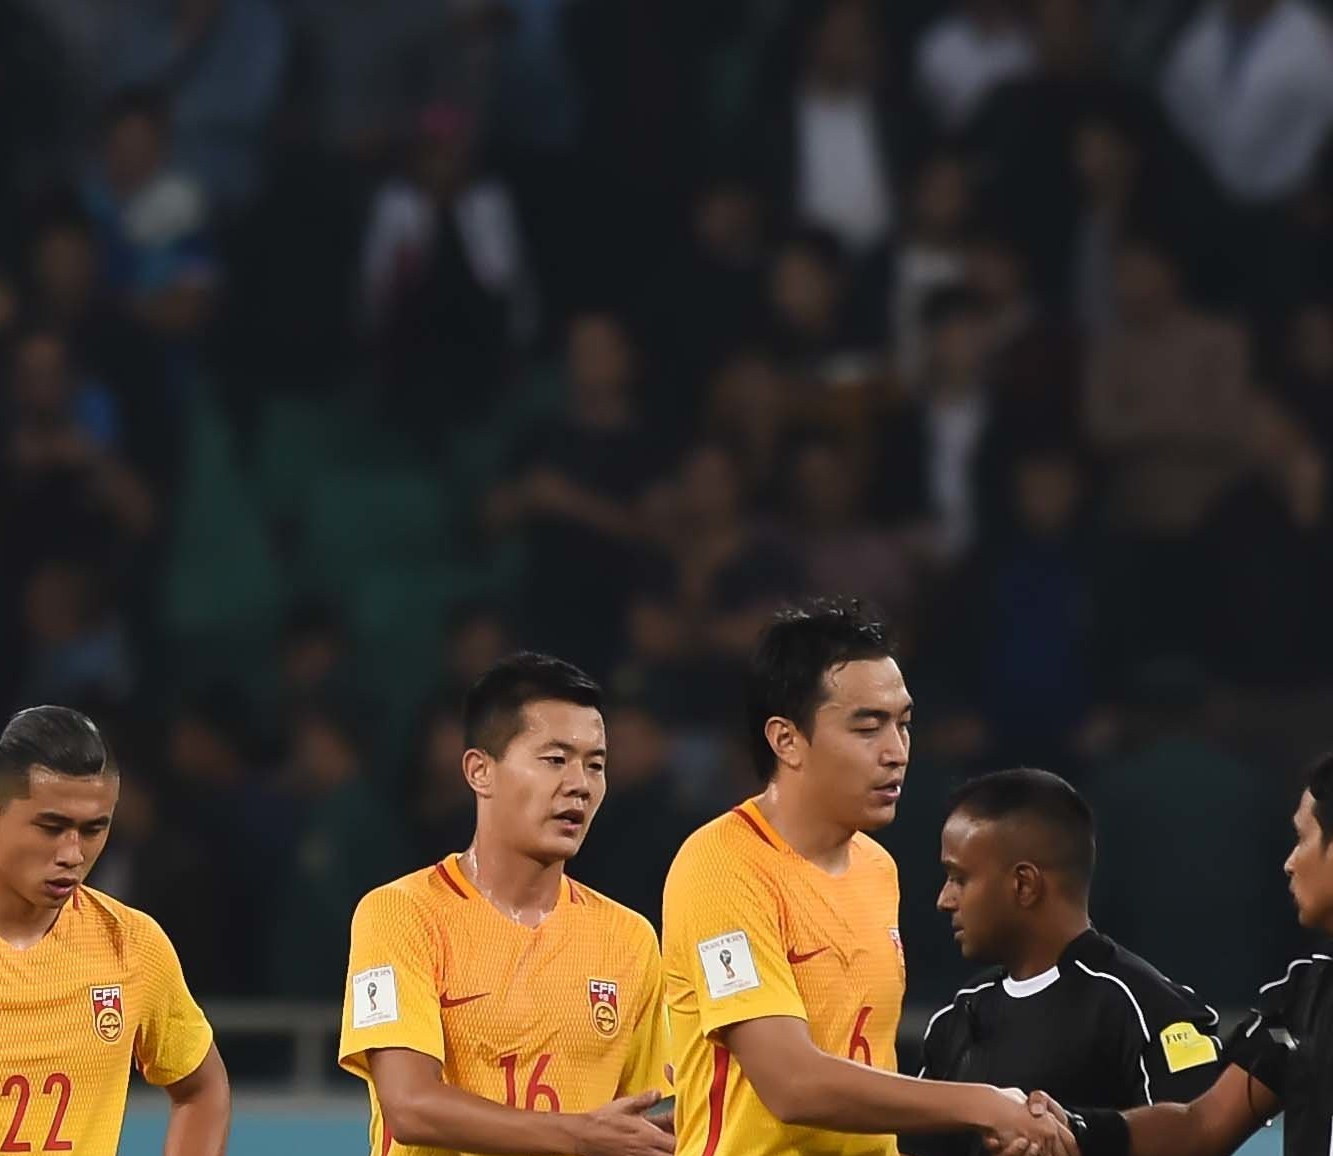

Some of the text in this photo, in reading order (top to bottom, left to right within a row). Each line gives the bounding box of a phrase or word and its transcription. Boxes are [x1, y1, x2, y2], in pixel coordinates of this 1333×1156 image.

[93, 987, 120, 1001] CFA
[590, 980, 617, 996] CFA
[499, 1053, 561, 1112] 16
[0, 1072, 73, 1153] 22
